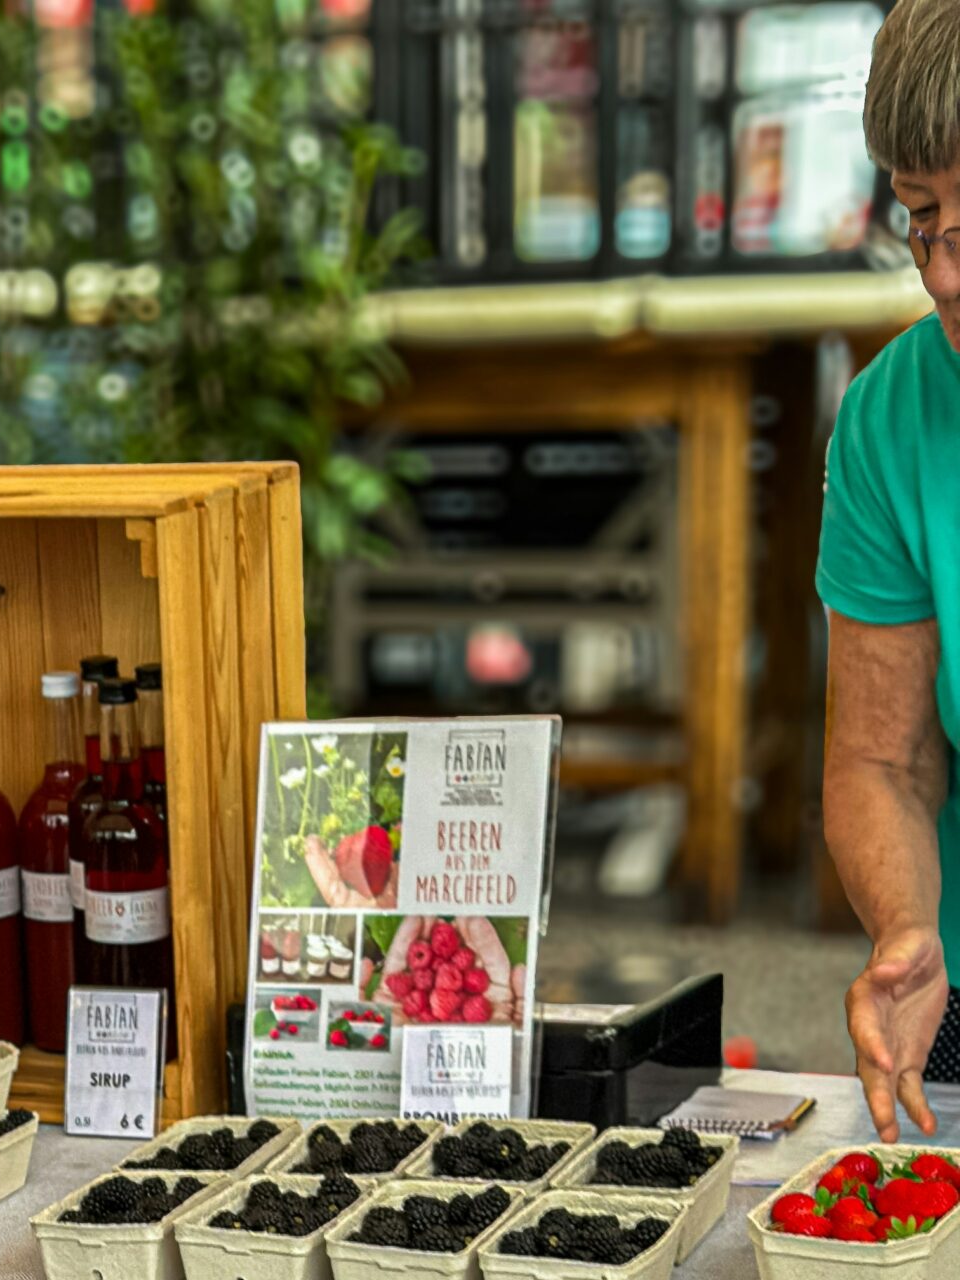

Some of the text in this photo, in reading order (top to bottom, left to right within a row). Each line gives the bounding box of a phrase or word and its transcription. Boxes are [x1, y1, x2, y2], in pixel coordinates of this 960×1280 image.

[445, 742, 507, 772] FABIAN
[436, 819, 502, 852] BEEREN
[444, 852, 490, 871] AUS DEM
[415, 872, 517, 905] MARCHFELD
[86, 1003, 138, 1030] FABIAN
[426, 1041, 487, 1070] FABIAN
[90, 1072, 131, 1089] SIRUP
[120, 1113, 129, 1130] 6
[133, 1114, 145, 1131] €
